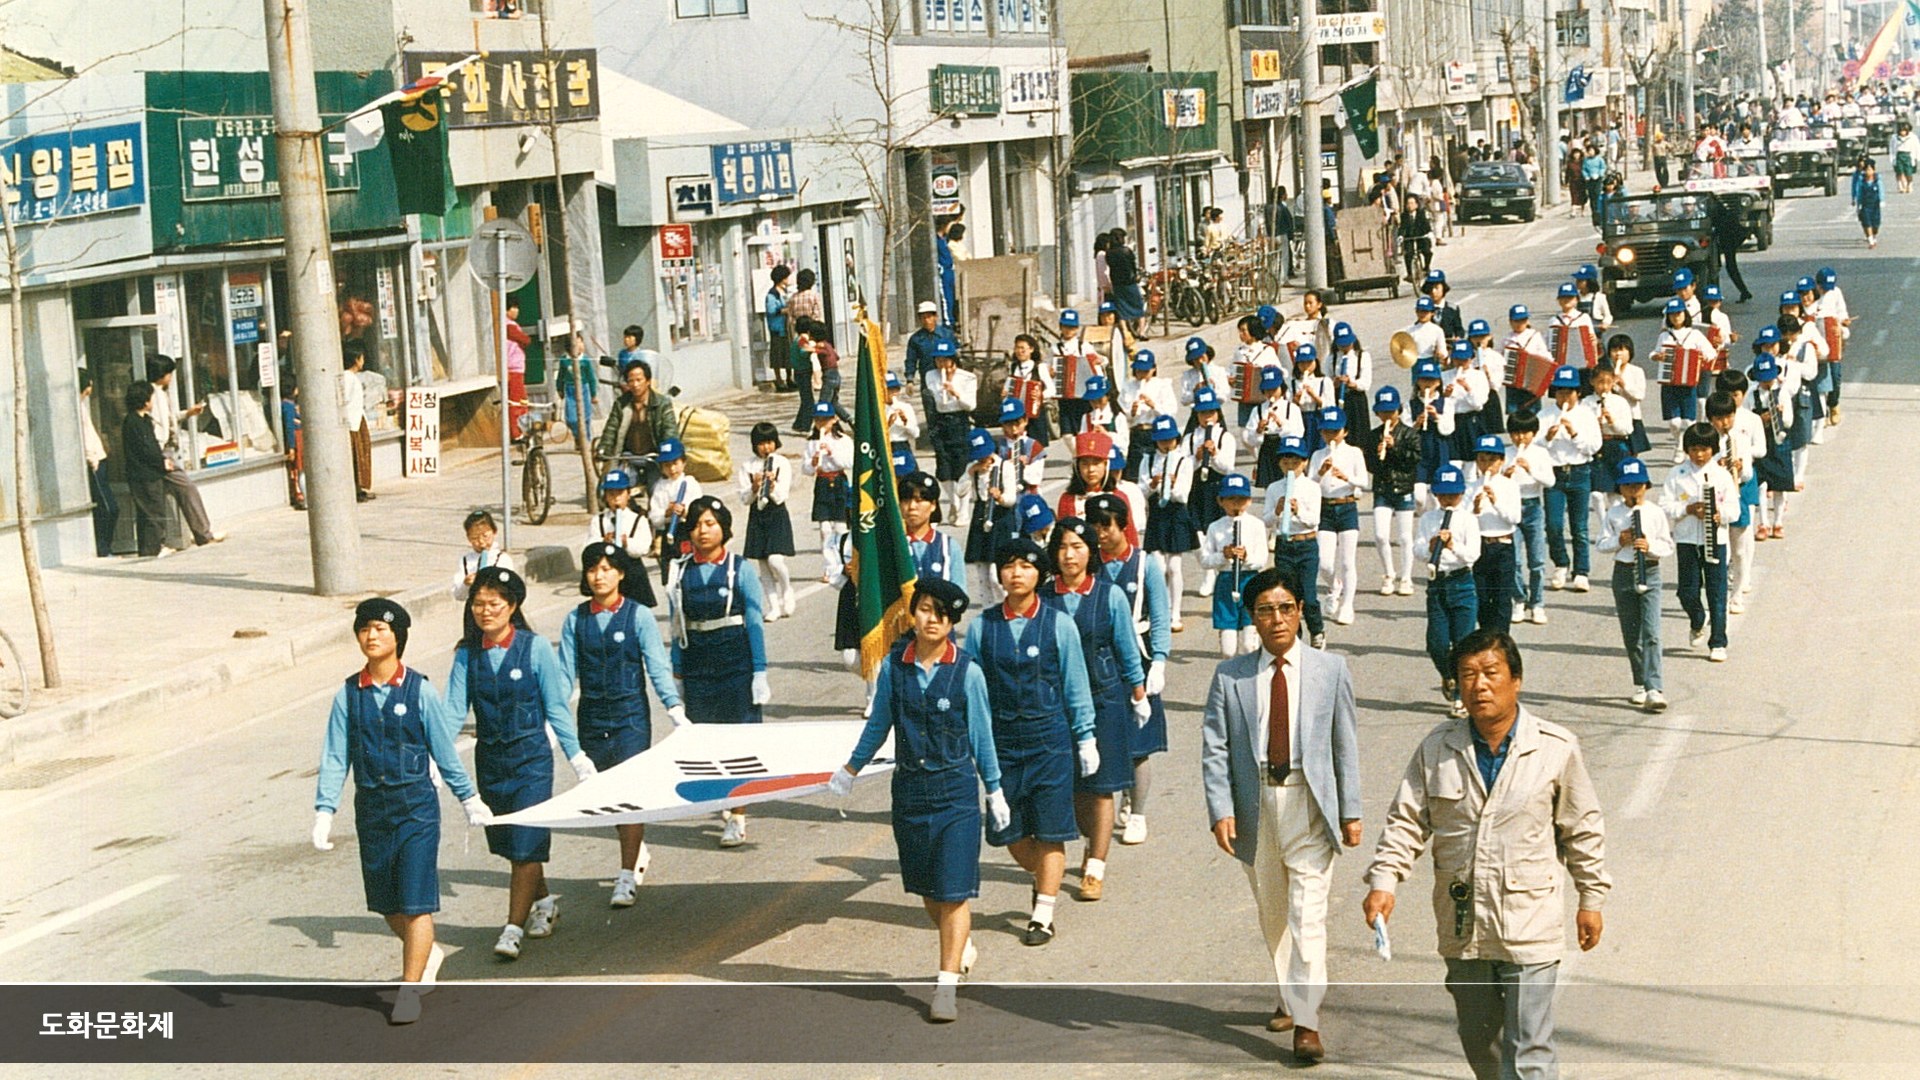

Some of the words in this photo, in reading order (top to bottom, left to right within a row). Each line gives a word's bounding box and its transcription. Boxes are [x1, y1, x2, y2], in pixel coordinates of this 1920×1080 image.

[189, 133, 354, 187] 한성구
[675, 183, 714, 215] 책
[409, 392, 423, 474] 전자복사
[424, 392, 437, 473] 청사진
